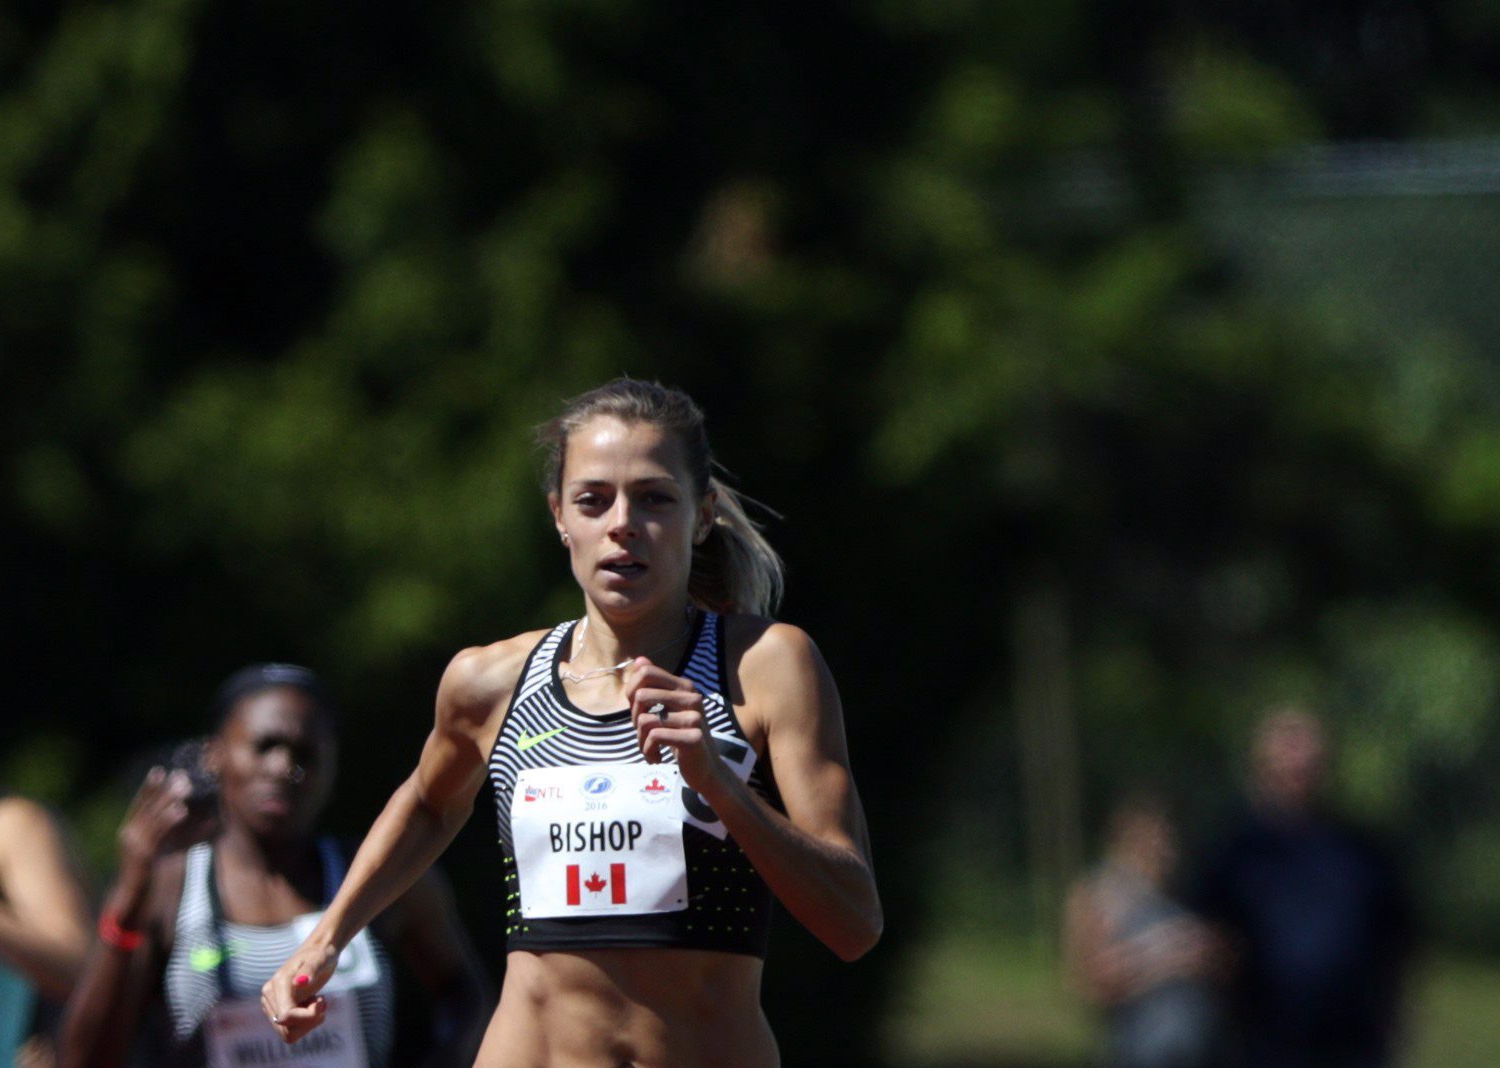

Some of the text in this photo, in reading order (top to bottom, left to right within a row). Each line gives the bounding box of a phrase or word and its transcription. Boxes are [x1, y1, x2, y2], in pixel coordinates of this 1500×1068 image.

[538, 786, 563, 799] NTL
[584, 801, 608, 811] 2016
[550, 820, 642, 853] BISHOP
